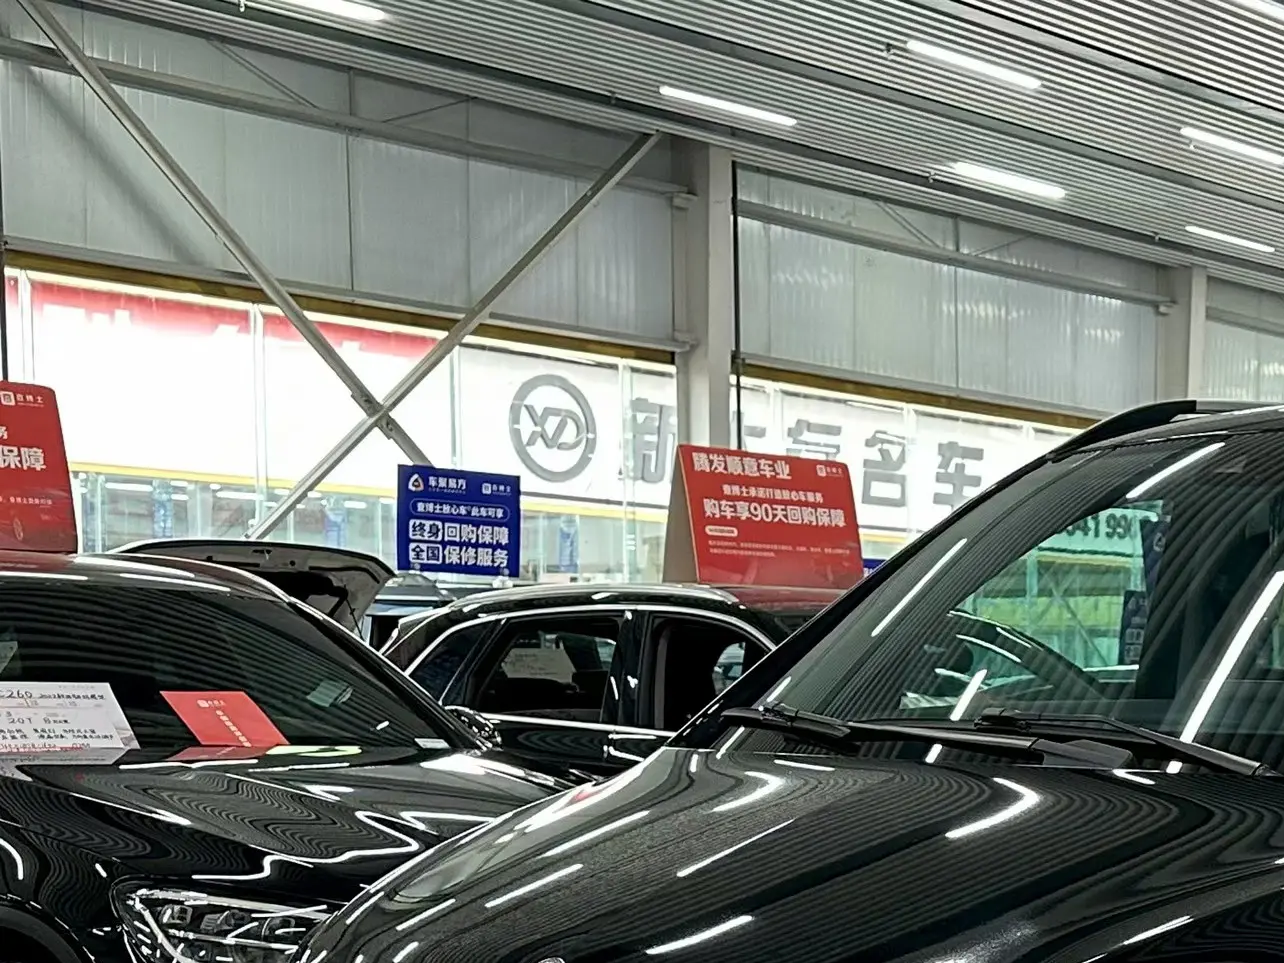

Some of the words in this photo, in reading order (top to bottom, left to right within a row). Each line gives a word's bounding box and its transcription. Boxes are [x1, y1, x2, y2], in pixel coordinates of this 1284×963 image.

[0, 445, 47, 471] 保障
[692, 452, 792, 480] 腾发顺意车业
[703, 498, 847, 527] 购车享90天回购保障
